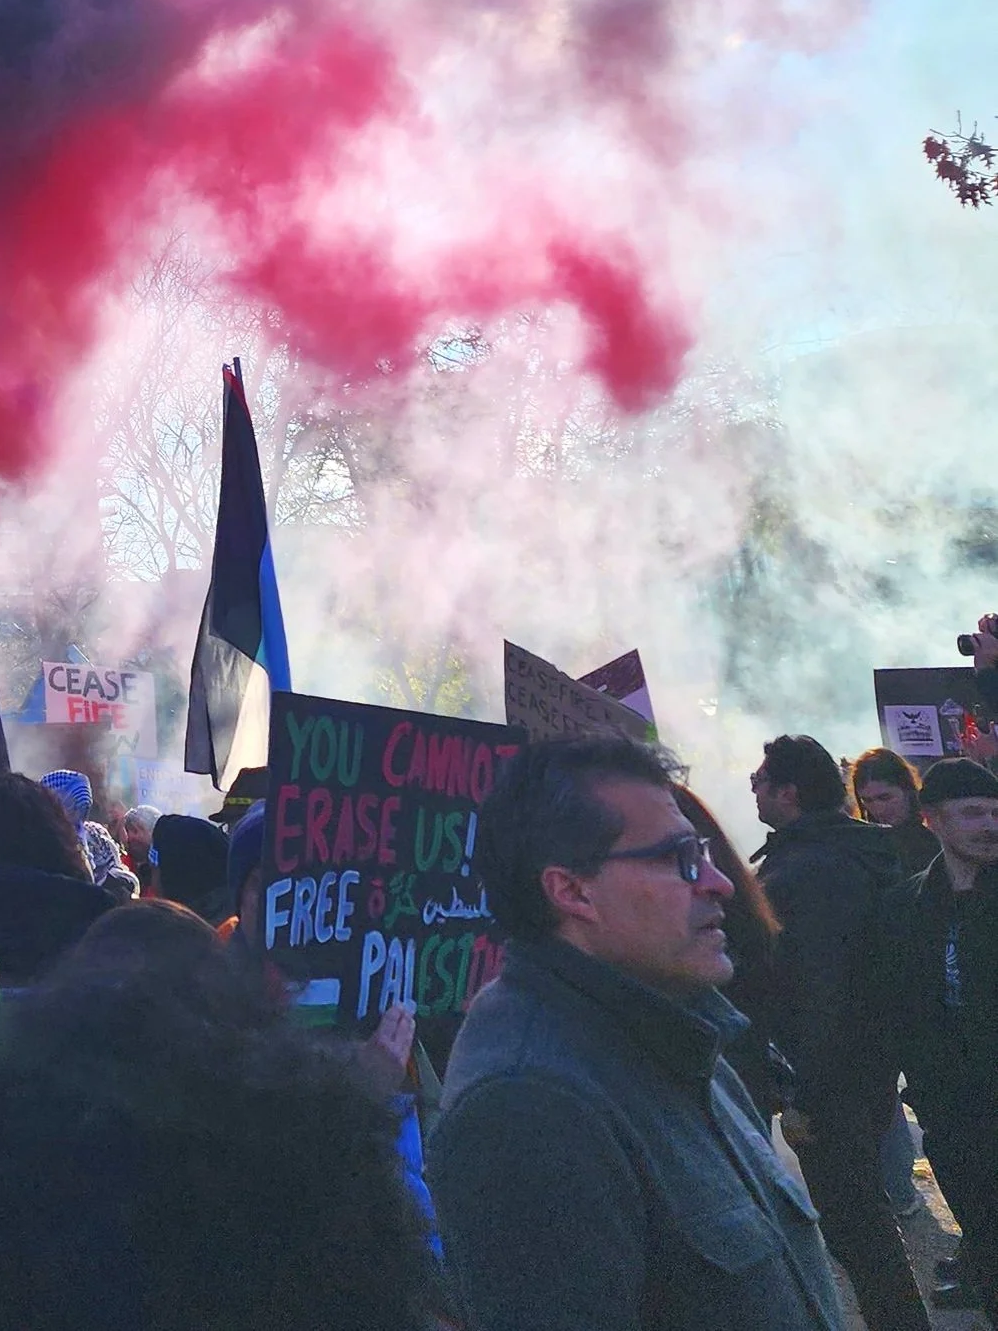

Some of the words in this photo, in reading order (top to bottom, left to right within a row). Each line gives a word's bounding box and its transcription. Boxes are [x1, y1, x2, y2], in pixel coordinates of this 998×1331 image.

[48, 665, 140, 704] CEASE
[286, 711, 363, 788] YOU
[275, 785, 402, 872] ERASE
[414, 806, 478, 877] US!
[265, 869, 361, 950] FREE
[356, 930, 507, 1021] PALESTIN
